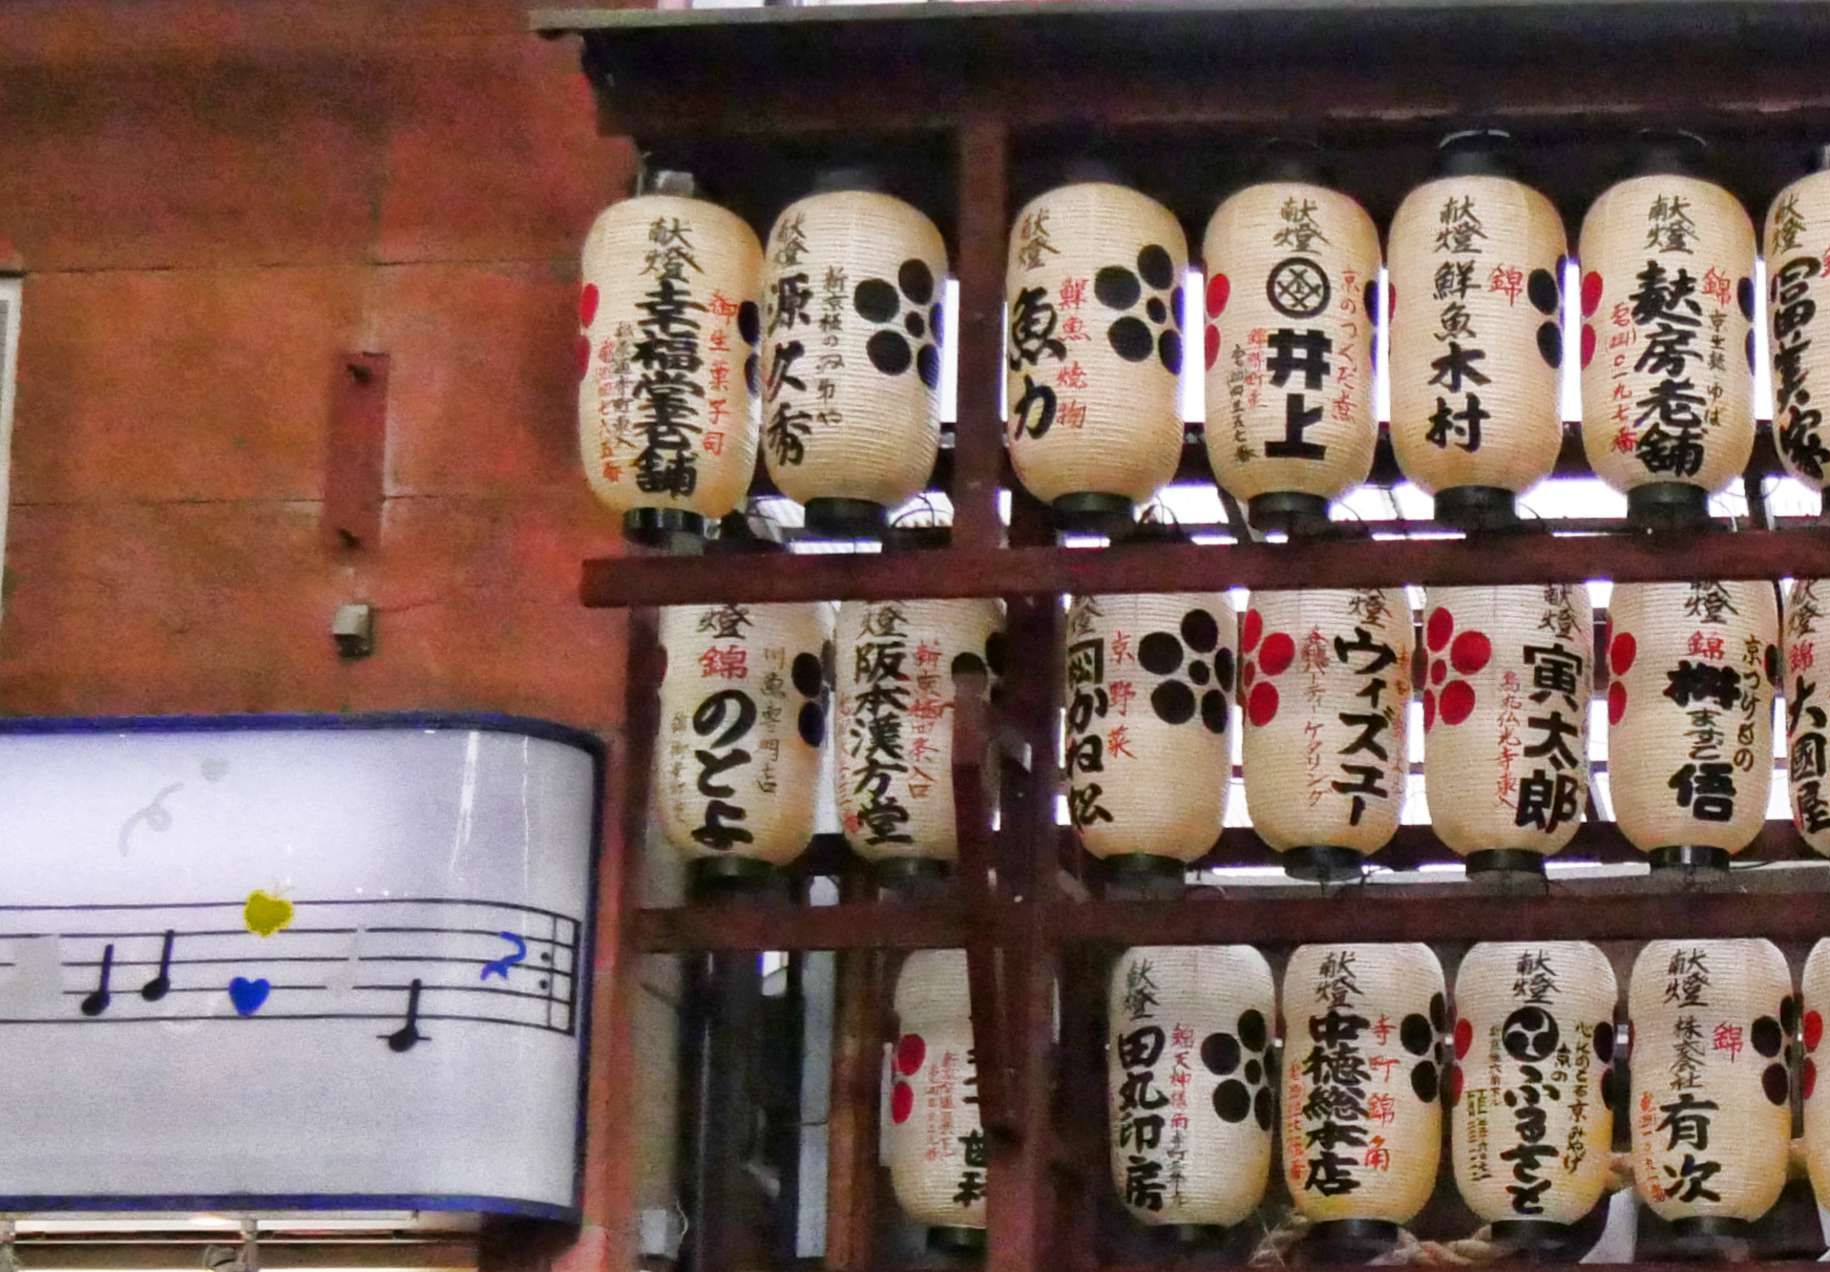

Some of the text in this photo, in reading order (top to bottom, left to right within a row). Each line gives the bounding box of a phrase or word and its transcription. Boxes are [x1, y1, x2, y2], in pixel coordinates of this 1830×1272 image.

[1488, 265, 1524, 306] 錦
[1701, 265, 1732, 307] 錦
[1264, 328, 1333, 461] 井上
[698, 644, 749, 681] 錦
[691, 688, 757, 851] のとよ
[1711, 1022, 1745, 1064] 錦
